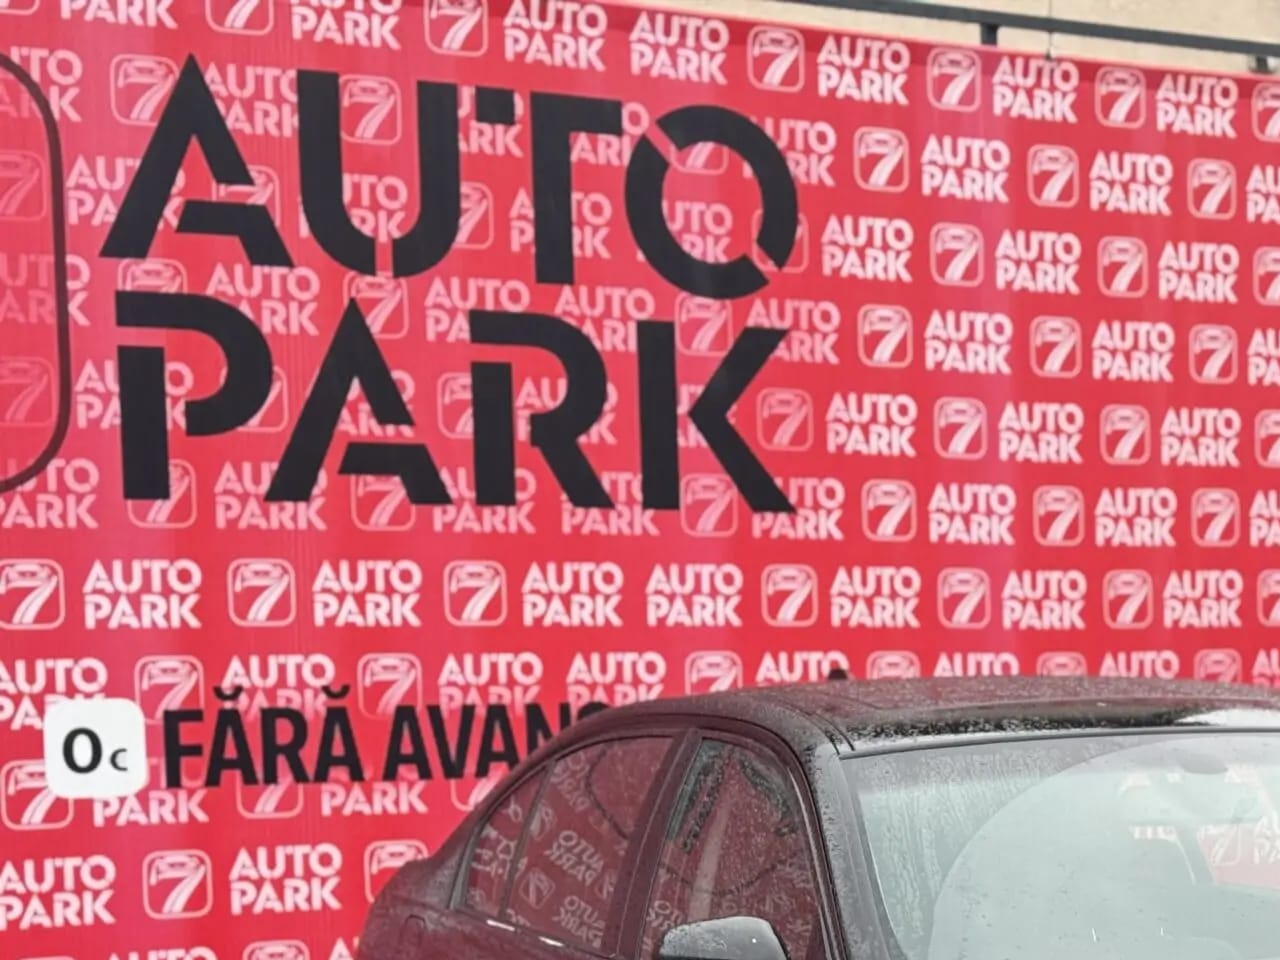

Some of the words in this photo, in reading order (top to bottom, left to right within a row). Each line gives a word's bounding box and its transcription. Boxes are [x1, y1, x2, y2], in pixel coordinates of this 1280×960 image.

[291, 7, 402, 50] PARK
[504, 0, 607, 37] AUTO
[630, 10, 731, 52] AUTO
[10, 46, 83, 85] TO
[505, 27, 605, 71] PARK
[631, 42, 726, 84] PARK
[817, 34, 912, 73] AUTO
[818, 64, 908, 105] PARK
[992, 54, 1081, 92] AUTO
[993, 84, 1077, 123] PARK
[1156, 76, 1237, 108] AUTO
[762, 117, 836, 154] UTO
[1157, 101, 1236, 138] PARK
[921, 135, 1010, 171] AUTO
[1090, 152, 1172, 185] AUTO
[99, 53, 798, 300] AUTO
[922, 164, 1008, 202] PARK
[1091, 180, 1170, 215] PARK
[664, 200, 733, 236] UTO
[822, 216, 913, 250] AUTO
[823, 244, 911, 282] PARK
[995, 230, 1081, 264] AUTO
[1159, 242, 1239, 273] AUTO
[996, 259, 1079, 294] PARK
[1159, 269, 1237, 302] PARK
[424, 277, 531, 312] AUTO
[554, 284, 656, 319] AUTO
[425, 310, 470, 343] PA
[747, 298, 841, 333] AUTO
[925, 311, 1012, 343] AUTO
[1092, 321, 1174, 353] AUTO
[926, 339, 1010, 374] PARK
[1093, 348, 1172, 381] PARK
[115, 290, 798, 515] PARK
[827, 393, 917, 425] AUTO
[999, 403, 1083, 433] AUTO
[828, 422, 915, 456] PARK
[1161, 408, 1241, 437] AUTO
[999, 432, 1081, 463] PARK
[1161, 435, 1238, 466] PARK
[0, 493, 98, 530] ARK
[929, 484, 1016, 514] AUTO
[1095, 488, 1177, 518] AUTO
[930, 513, 1013, 544] PARK
[1096, 516, 1175, 546] PARK
[83, 560, 201, 594] AUTO
[312, 560, 422, 593] AUTO
[522, 562, 623, 594] AUTO
[646, 564, 742, 595] AUTO
[831, 567, 921, 597] AUTO
[1002, 570, 1086, 600] AUTO
[1163, 570, 1243, 599] AUTO
[85, 594, 200, 629] PARK
[314, 592, 420, 626] PARK
[523, 592, 622, 626] PARK
[647, 594, 741, 626] PARK
[831, 596, 919, 627] PARK
[1003, 599, 1084, 629] PARK
[1164, 597, 1241, 628] PARK
[221, 653, 337, 693] AUTO
[438, 651, 544, 686] AUTO
[566, 651, 666, 685] AUTO
[1100, 650, 1180, 679] AUTO
[163, 685, 365, 788] FĂRĂ
[383, 702, 612, 782] AVAN
[321, 780, 428, 817] PARK
[0, 855, 116, 894] AUTO
[230, 843, 342, 881] AUTO
[0, 890, 115, 930] PARK
[231, 876, 340, 914] PARK
